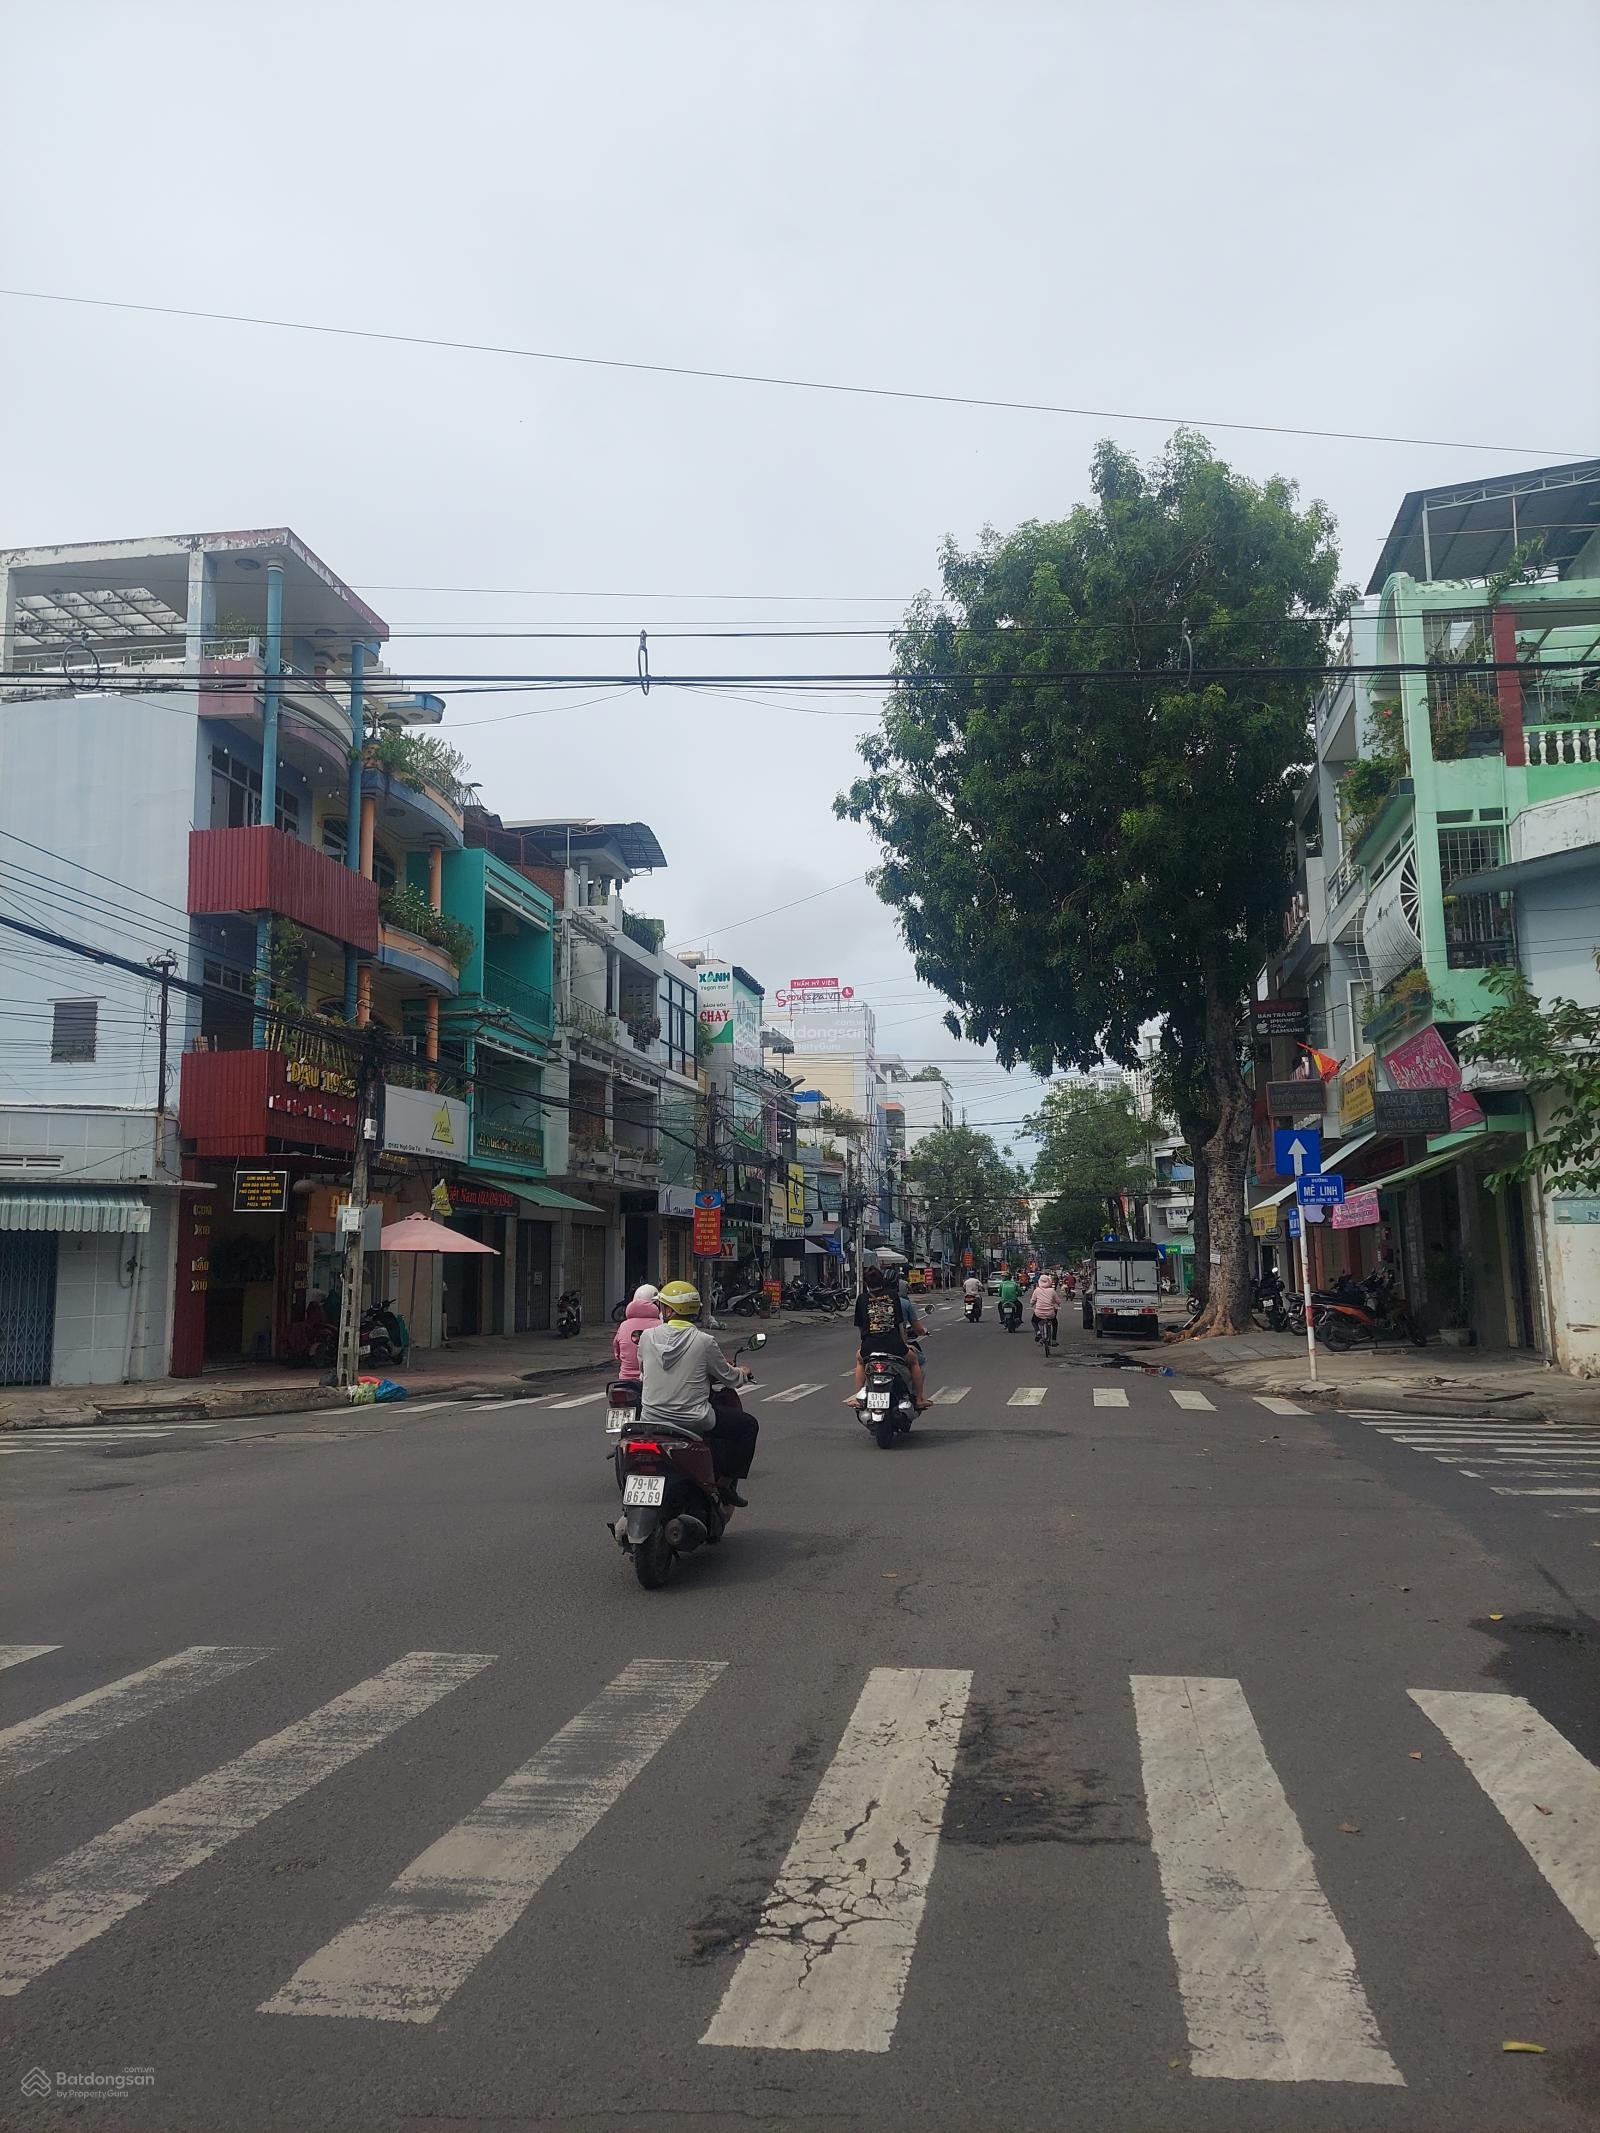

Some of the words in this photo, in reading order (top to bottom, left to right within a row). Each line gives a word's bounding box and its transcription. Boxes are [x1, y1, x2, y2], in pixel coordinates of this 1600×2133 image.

[699, 971, 731, 983] XANH
[700, 1009, 730, 1022] CHAY
[1303, 1184, 1316, 1196] MÊ
[1320, 1186, 1337, 1196] LINH
[632, 1478, 658, 1491] 79-N2
[626, 1490, 661, 1504] 862.69
